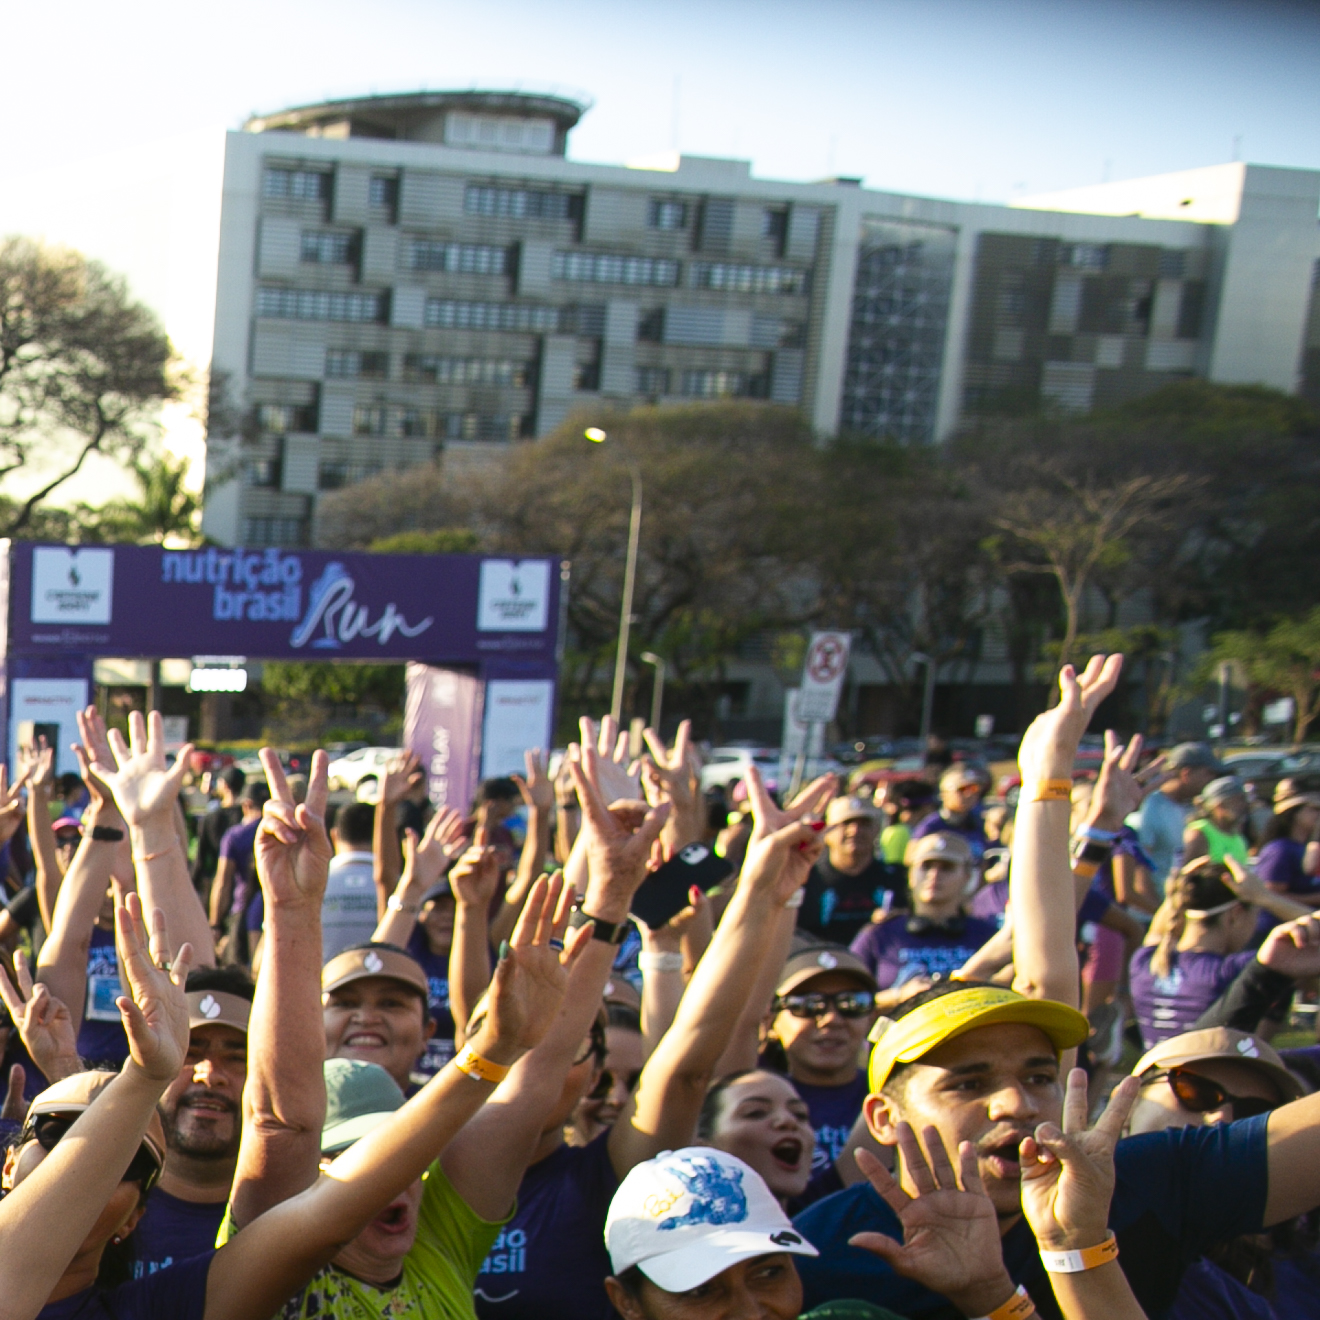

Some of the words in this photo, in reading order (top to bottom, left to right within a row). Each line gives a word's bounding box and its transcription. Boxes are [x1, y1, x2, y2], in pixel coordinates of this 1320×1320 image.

[161, 547, 302, 591] nutrição
[212, 584, 302, 622] brasil
[290, 576, 435, 648] Run
